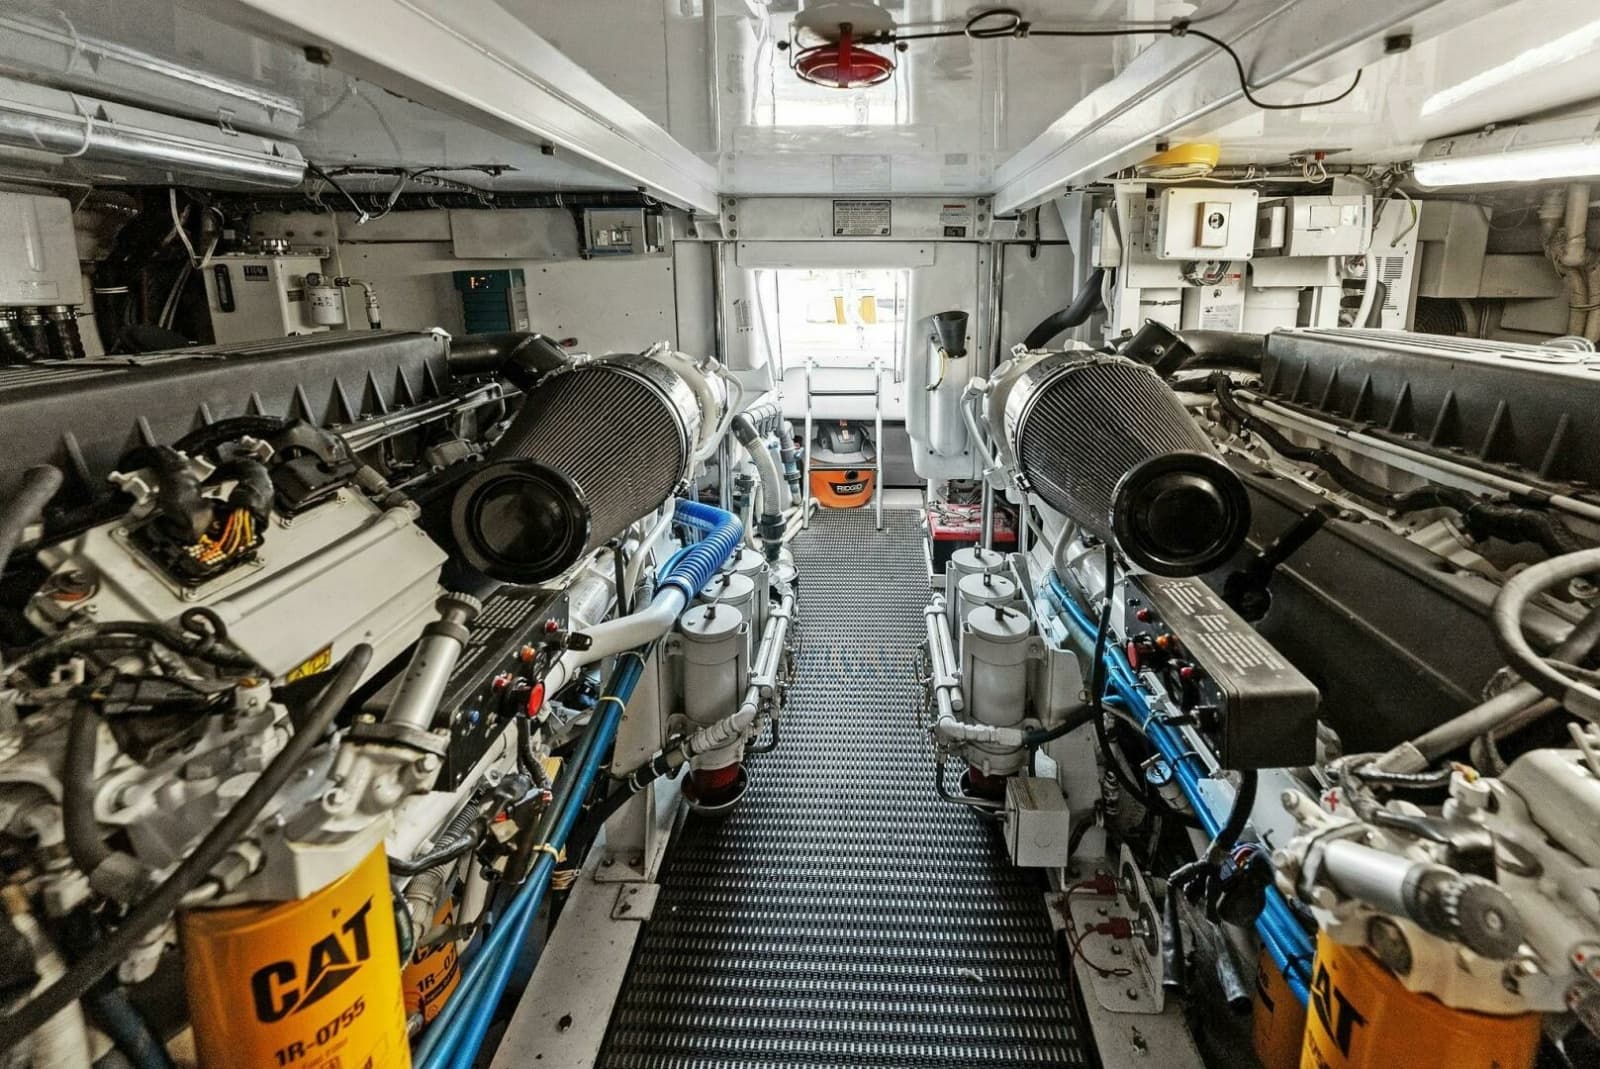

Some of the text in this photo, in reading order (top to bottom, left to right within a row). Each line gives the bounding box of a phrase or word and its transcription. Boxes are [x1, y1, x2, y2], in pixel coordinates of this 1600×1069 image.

[251, 895, 374, 1023] CAT
[274, 995, 366, 1067] 1R-0755
[1313, 960, 1369, 1060] AT
